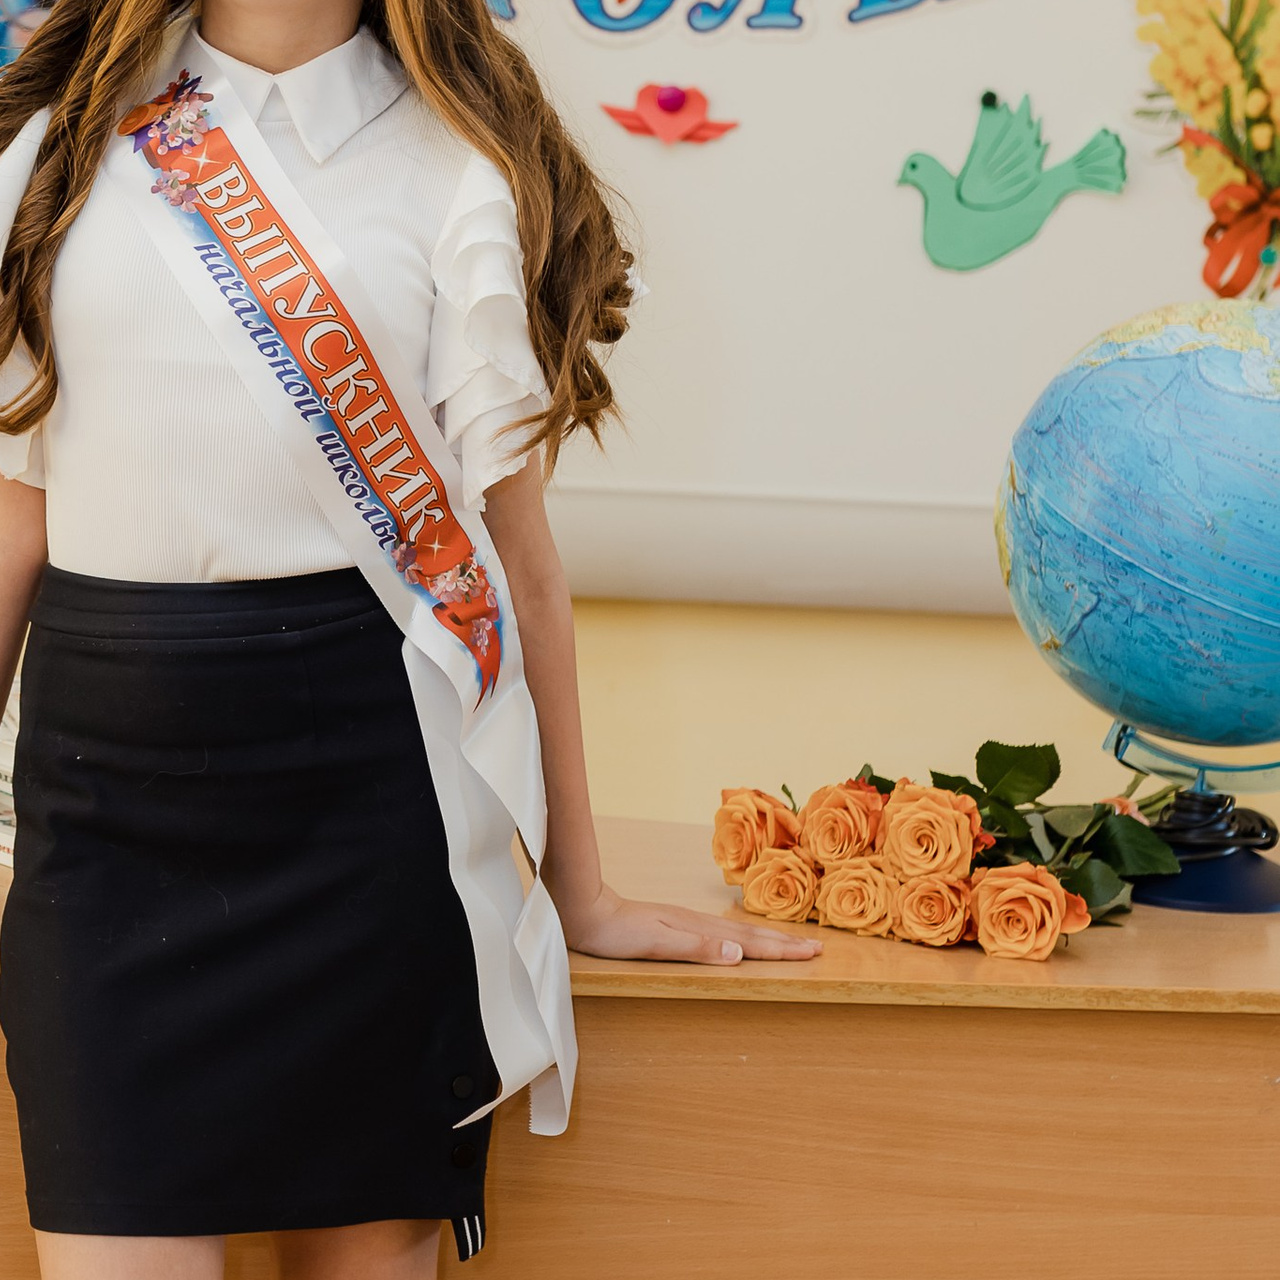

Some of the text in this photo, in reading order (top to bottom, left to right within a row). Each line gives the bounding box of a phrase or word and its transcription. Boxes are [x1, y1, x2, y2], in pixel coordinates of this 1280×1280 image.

[195, 242, 398, 550] начальной школы
[196, 163, 444, 543] ВЫПУСКНИК
